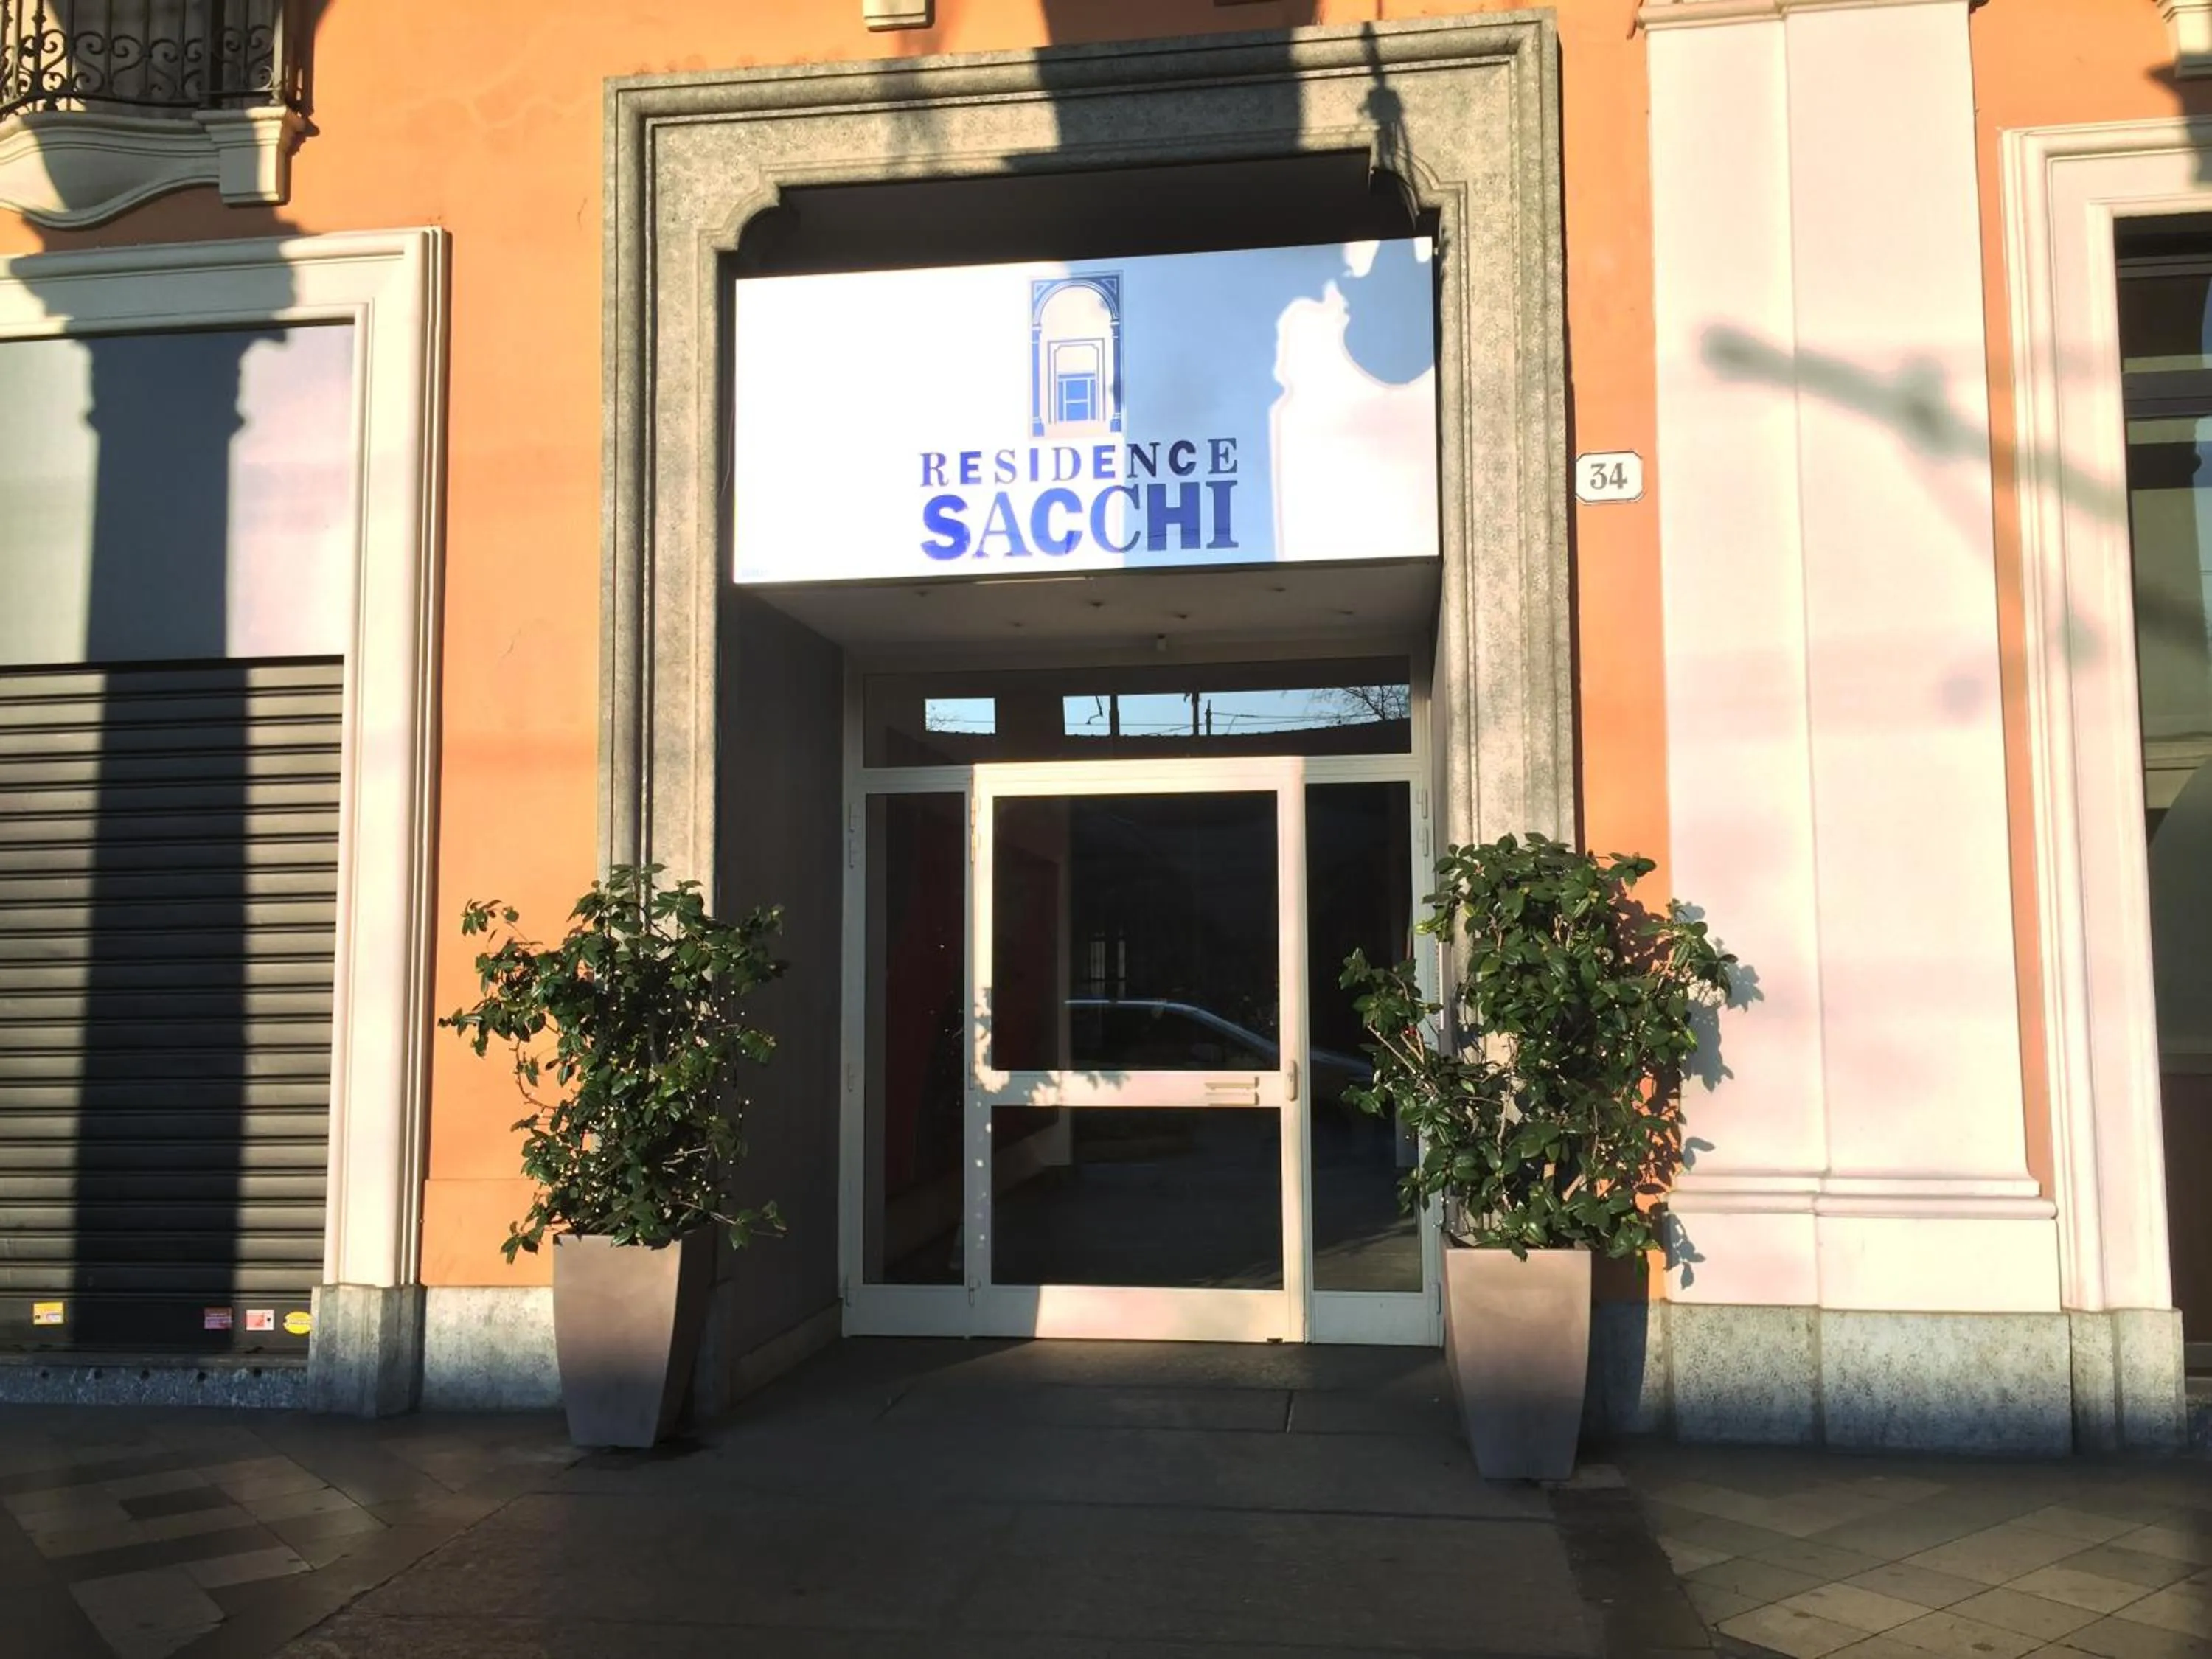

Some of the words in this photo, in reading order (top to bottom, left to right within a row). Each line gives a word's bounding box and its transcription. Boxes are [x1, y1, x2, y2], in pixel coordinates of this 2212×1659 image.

[920, 438, 1238, 487] RESIDENCE
[1590, 462, 1628, 490] 34
[920, 480, 1239, 560] SACCHI
